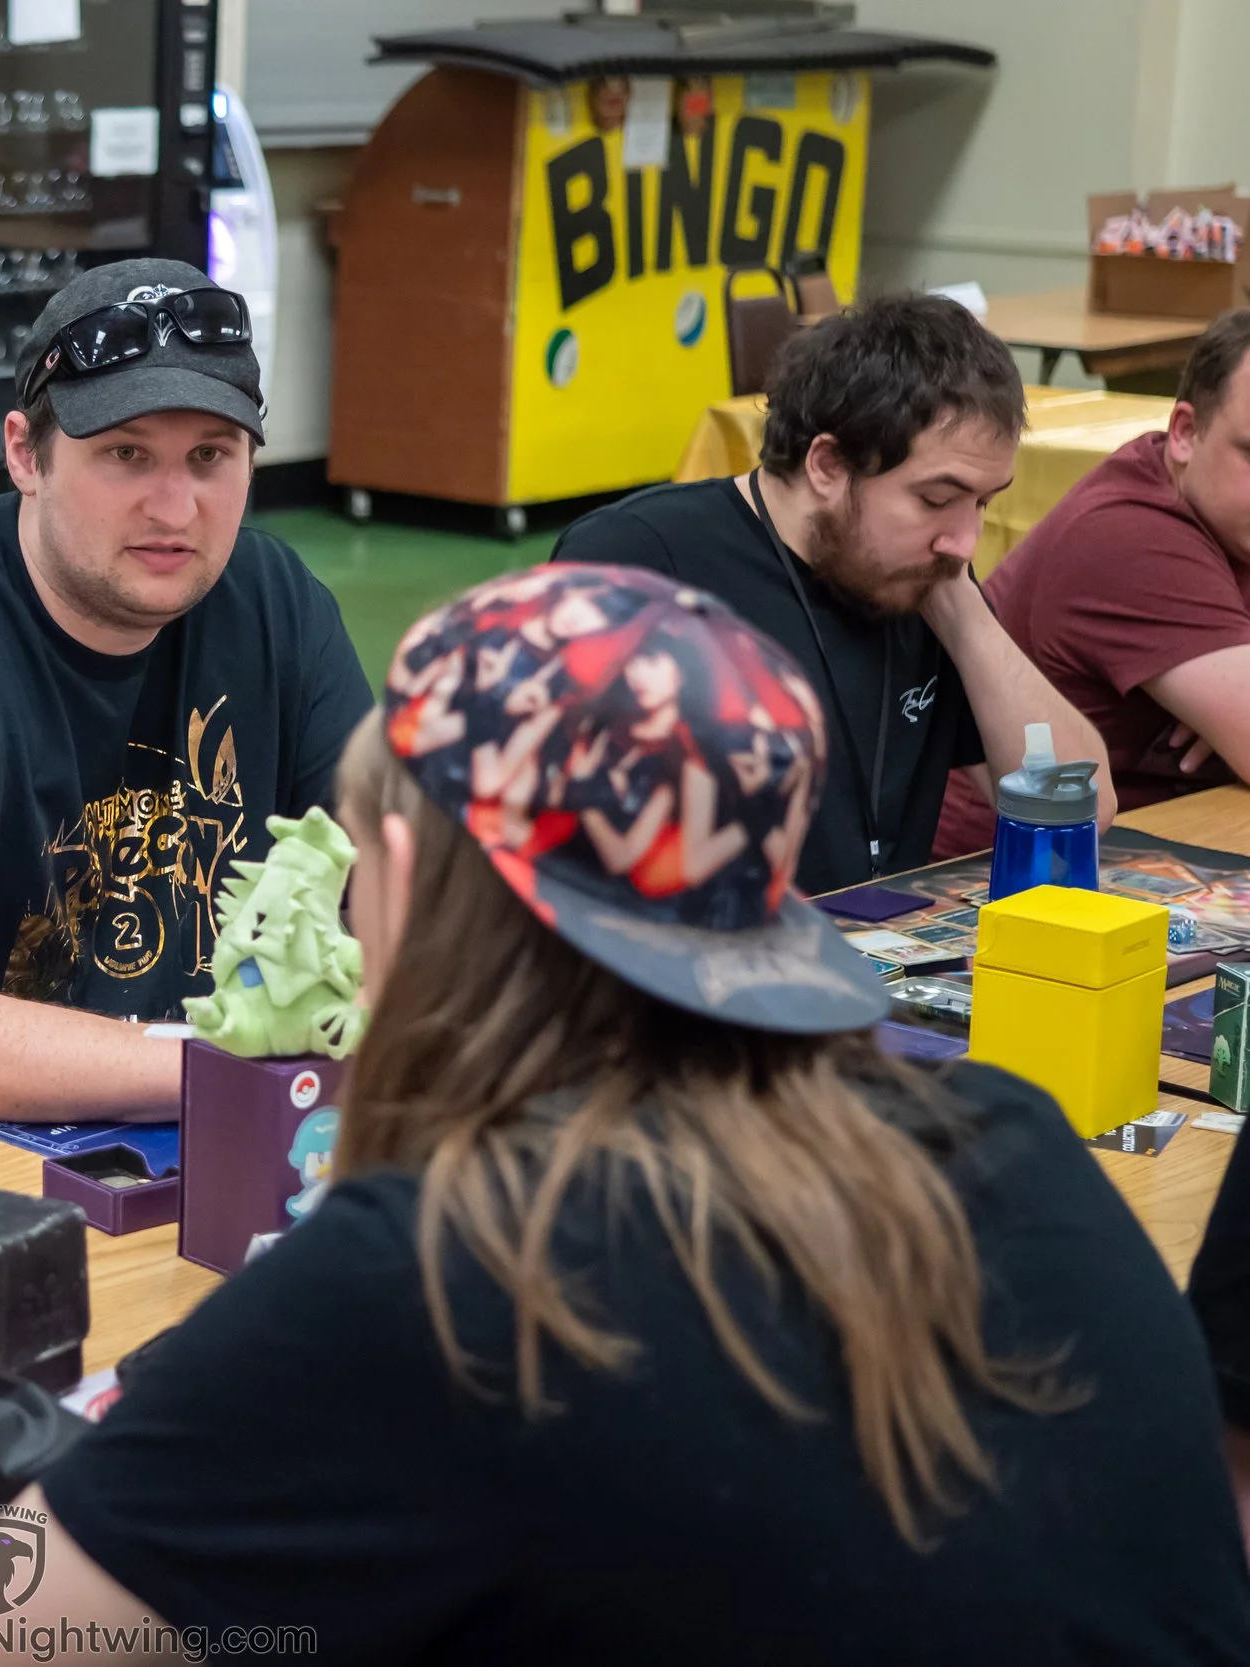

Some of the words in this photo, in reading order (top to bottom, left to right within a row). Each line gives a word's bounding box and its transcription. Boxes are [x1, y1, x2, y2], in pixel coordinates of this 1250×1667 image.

[547, 114, 846, 314] BINGO
[112, 912, 143, 951] 2
[50, 1125, 78, 1135] VIP
[1122, 1124, 1136, 1152] COLLECTION
